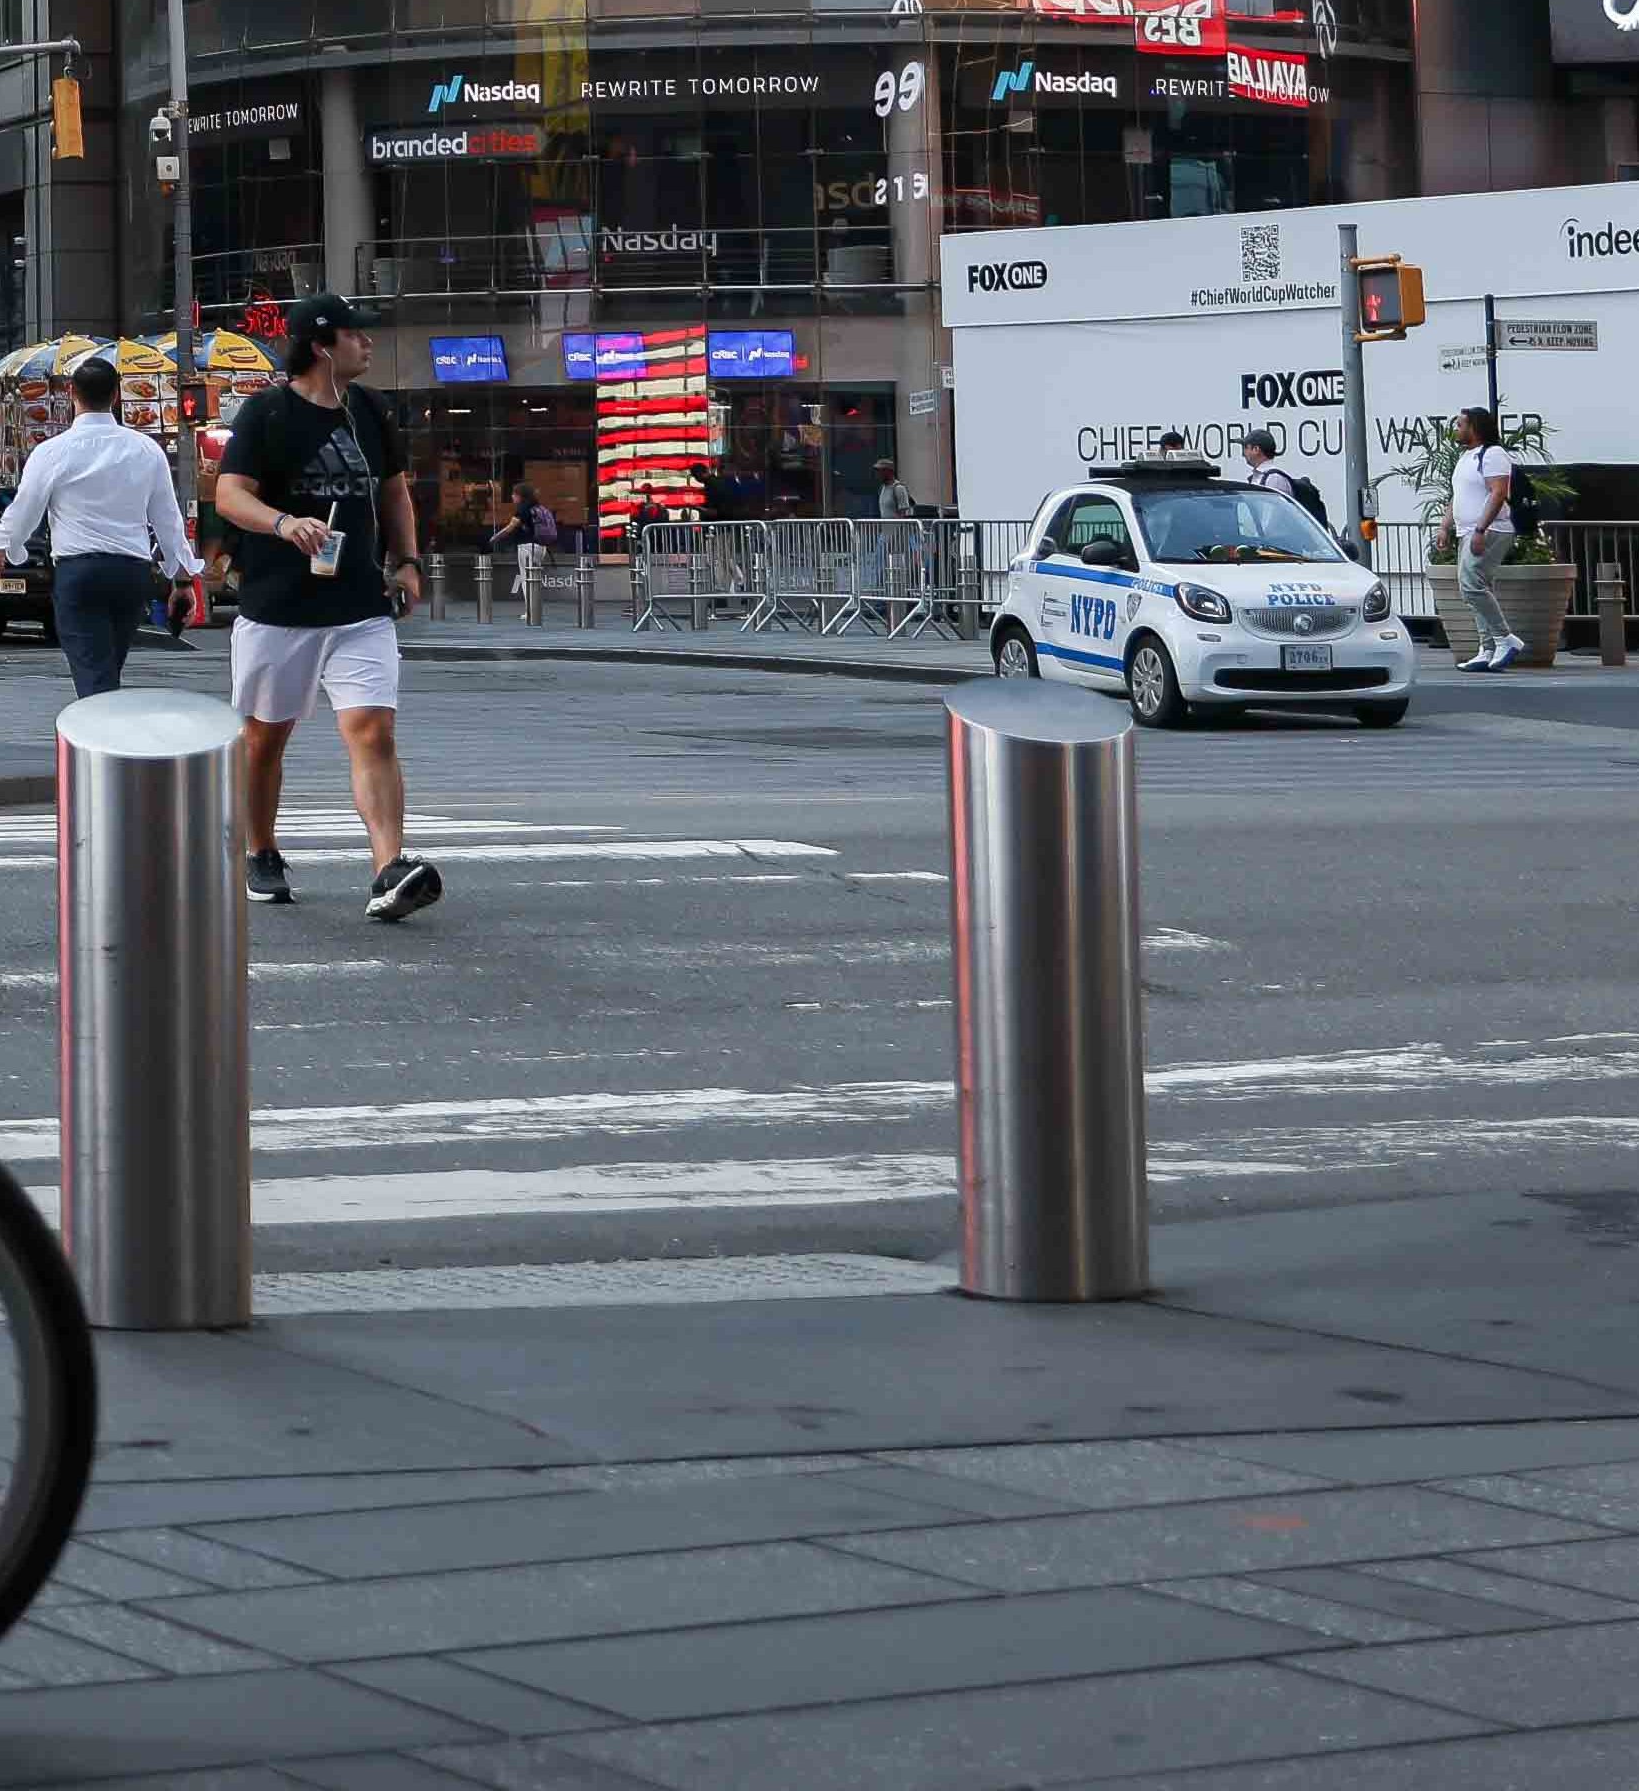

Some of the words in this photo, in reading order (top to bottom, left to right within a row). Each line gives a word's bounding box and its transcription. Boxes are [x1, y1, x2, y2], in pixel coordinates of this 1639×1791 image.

[464, 82, 540, 104] Nasdaq
[581, 79, 677, 98] REWRITE
[688, 76, 820, 95] TOMORROW
[1035, 71, 1118, 98] Nasdaq
[188, 114, 221, 134] EWRITE
[225, 103, 298, 127] TOMORROW
[967, 262, 1011, 293] FOX
[1011, 264, 1045, 287] ONE
[1190, 282, 1336, 307] #ChiefWorldCupWatcher
[1241, 372, 1300, 409] FOX
[1298, 418, 1343, 457] CU
[1266, 593, 1336, 606] POLICE
[1268, 582, 1322, 593] NYPD
[1070, 593, 1116, 640] NYPD
